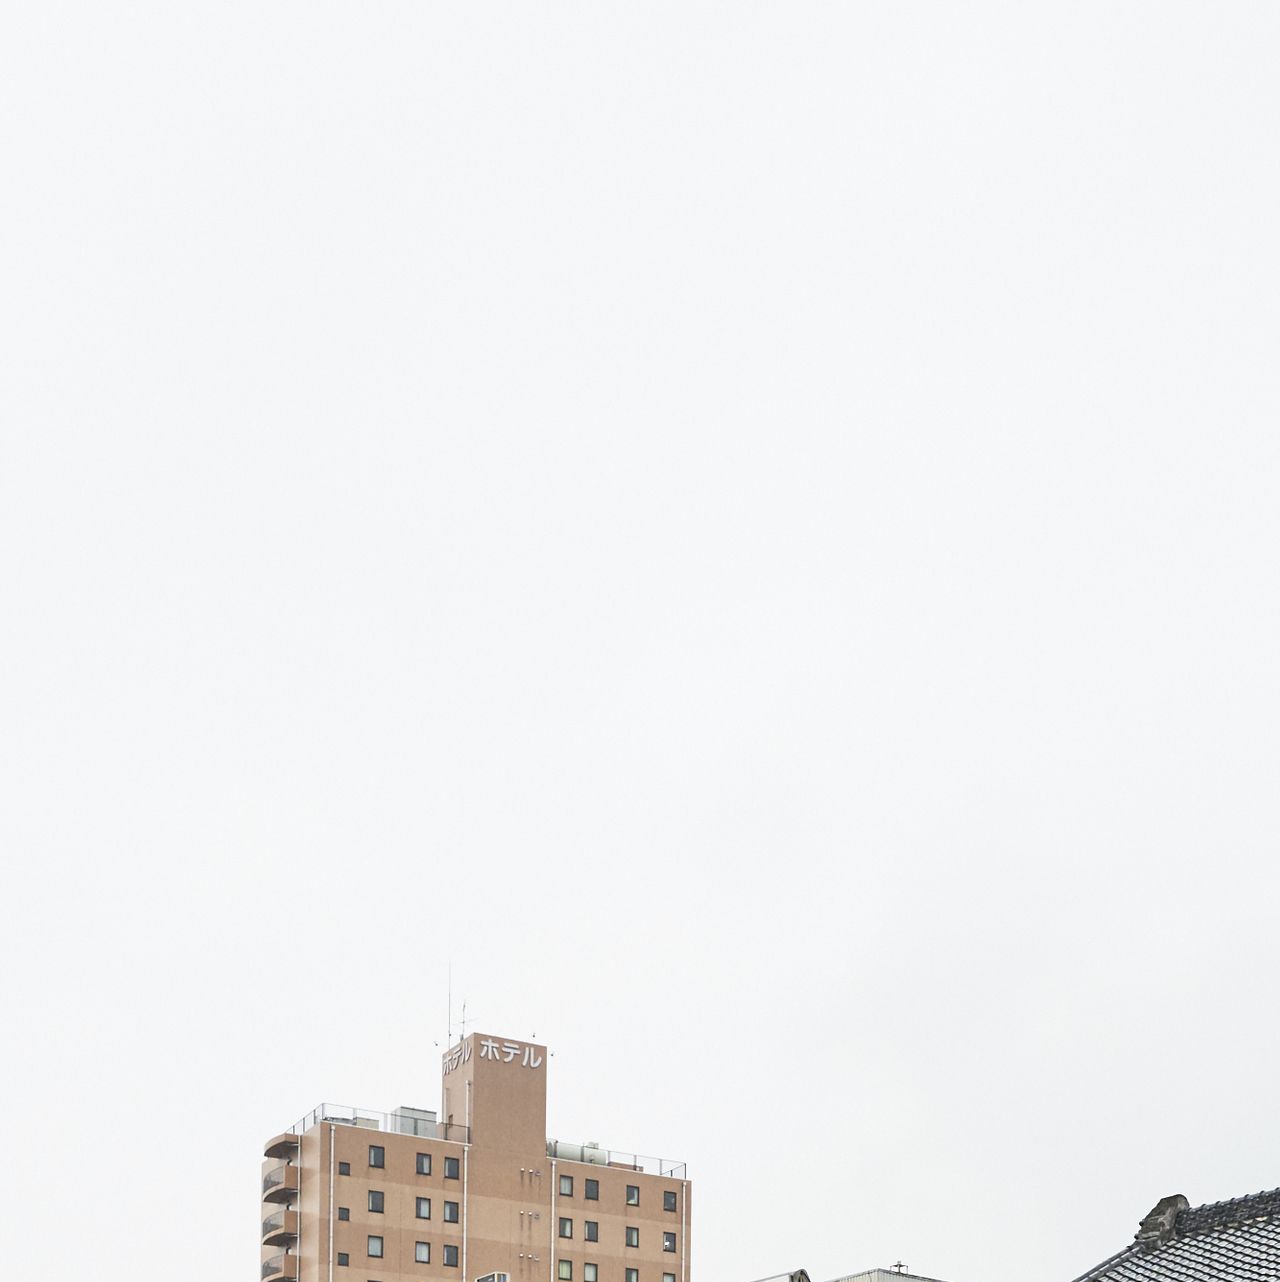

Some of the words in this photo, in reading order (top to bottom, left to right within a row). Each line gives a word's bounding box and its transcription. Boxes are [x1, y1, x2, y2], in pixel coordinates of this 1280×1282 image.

[442, 1041, 472, 1076] ホテル
[480, 1039, 543, 1068] ホテル
